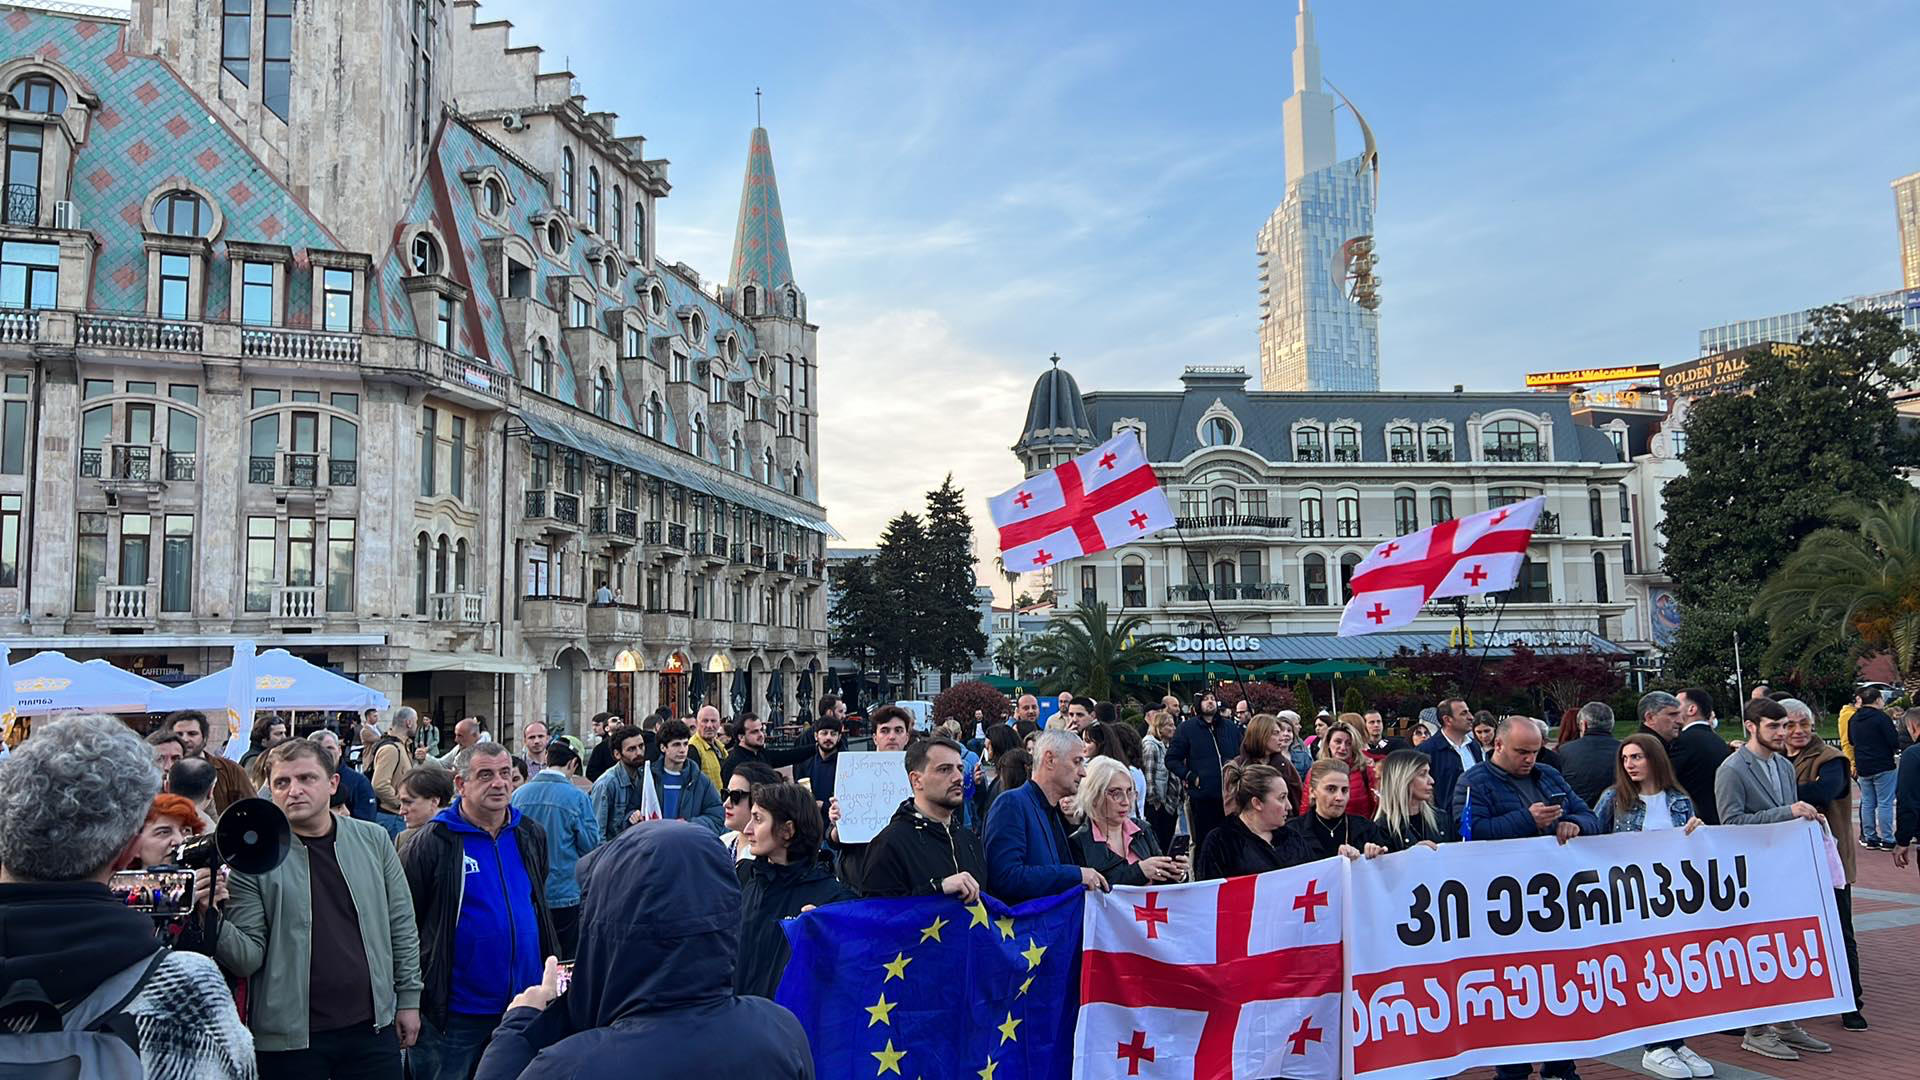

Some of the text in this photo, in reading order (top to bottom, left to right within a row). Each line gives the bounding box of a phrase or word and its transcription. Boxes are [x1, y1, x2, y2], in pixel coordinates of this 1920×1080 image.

[1664, 357, 1751, 387] GOLDEN PALA
[1396, 854, 1751, 947] კი ევროპას!
[1456, 954, 1627, 1025] რუსულ
[1636, 928, 1824, 1003] კანონს!
